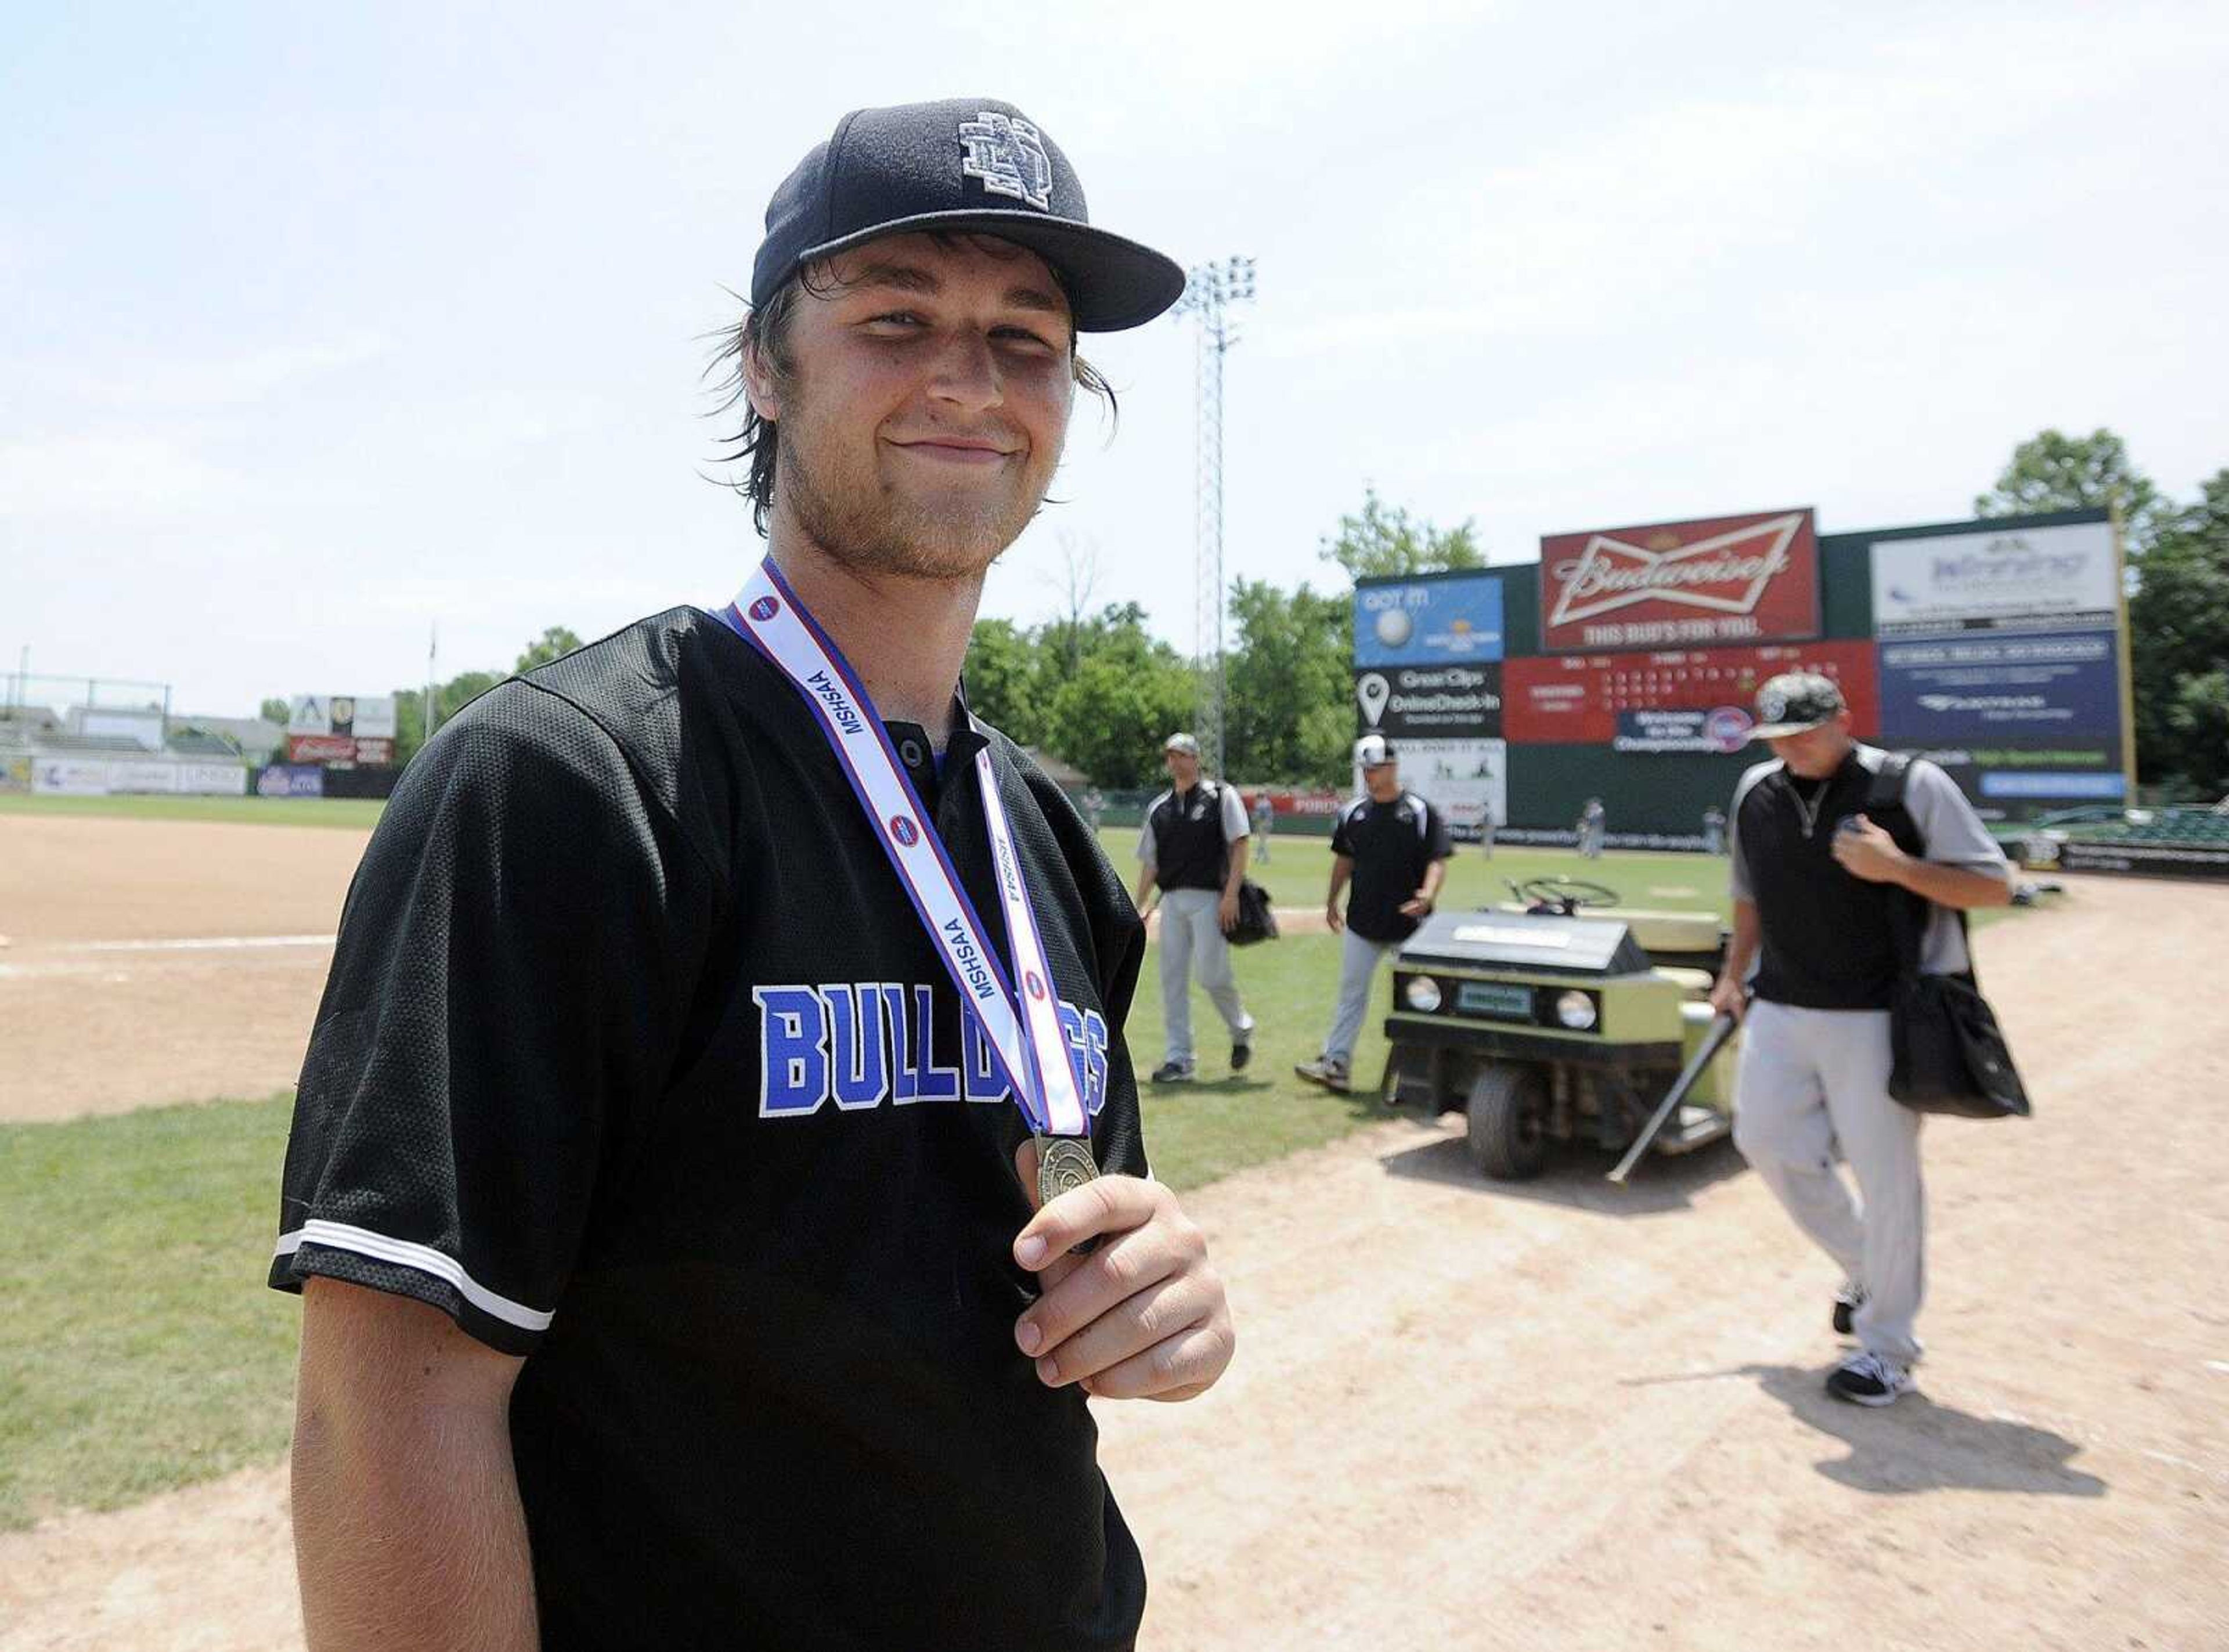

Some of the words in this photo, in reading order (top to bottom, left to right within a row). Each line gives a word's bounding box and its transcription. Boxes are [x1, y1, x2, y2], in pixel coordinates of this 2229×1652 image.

[1552, 549, 1790, 598] Budweiser
[1584, 626, 1623, 645] THIS
[1626, 623, 1679, 641] BUD'S
[1682, 620, 1718, 638] FOR
[807, 670, 864, 735] MSHSAA
[944, 918, 996, 1000] MSHSAA
[752, 983, 1108, 1118] BULLDGS
